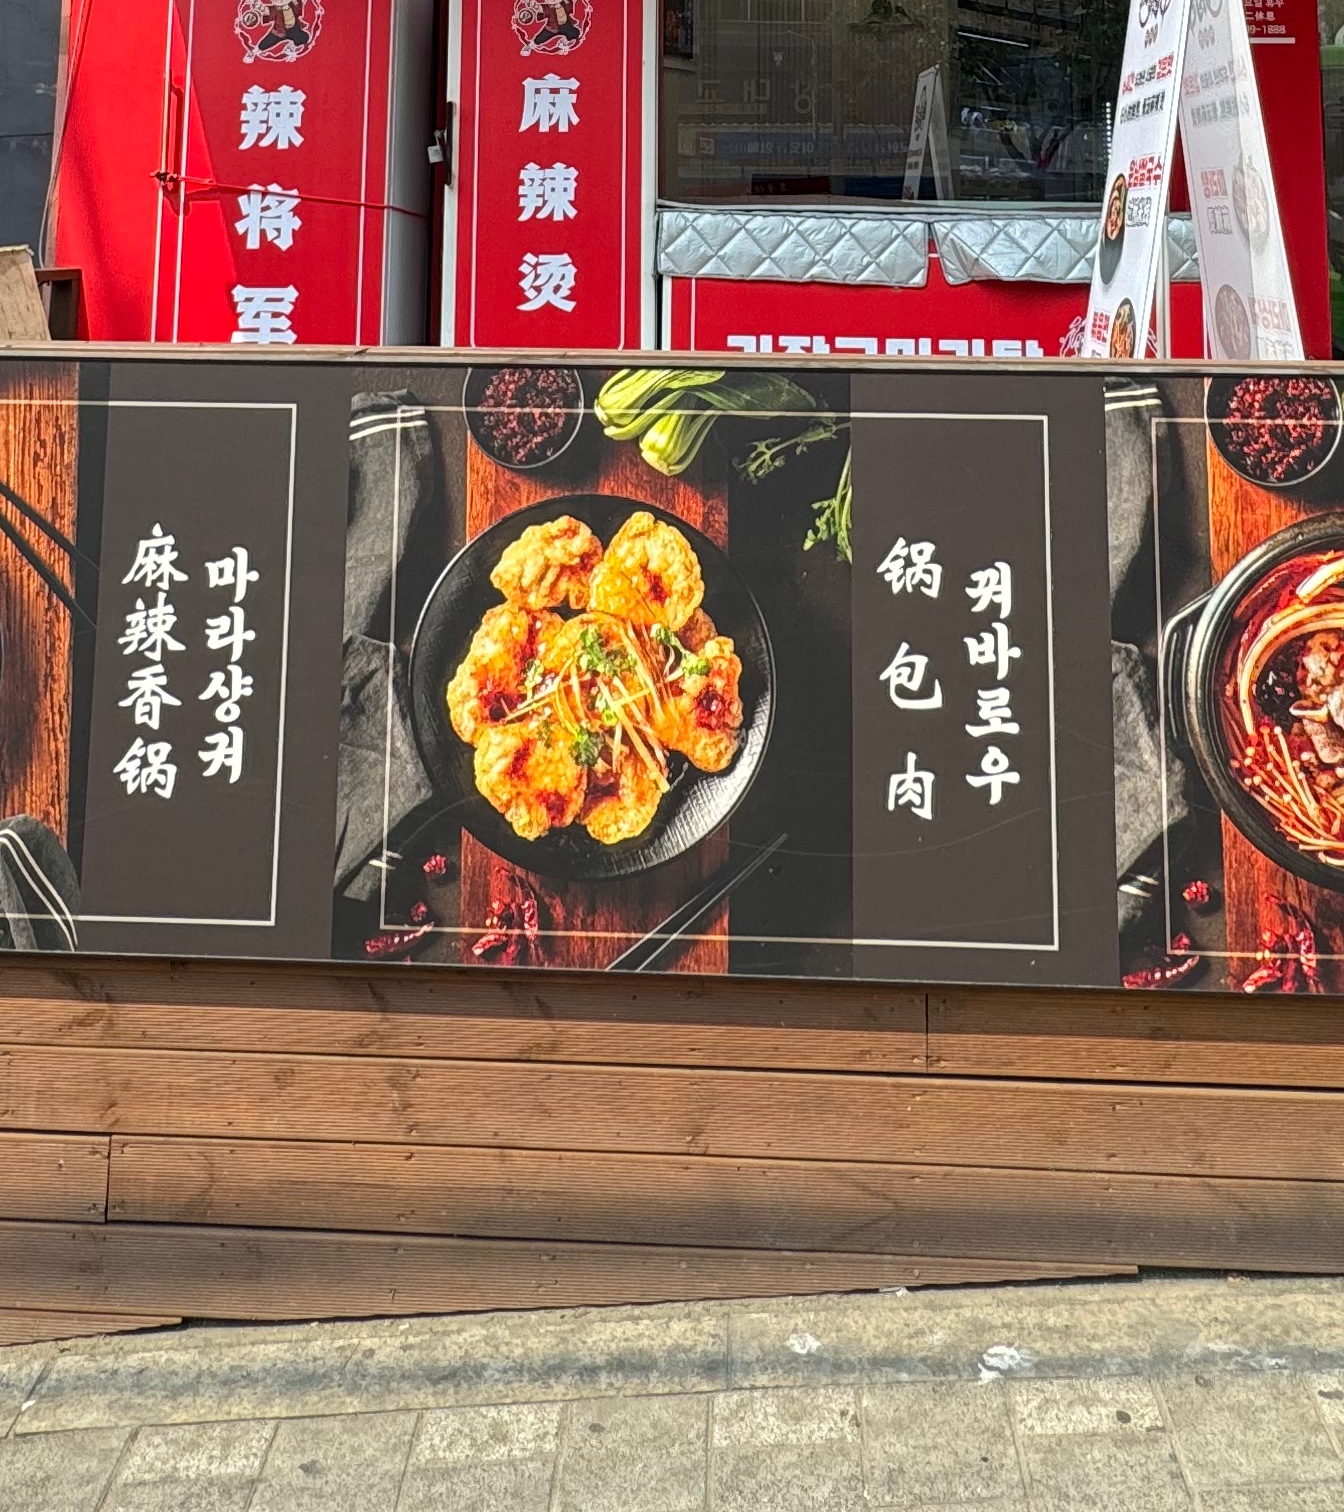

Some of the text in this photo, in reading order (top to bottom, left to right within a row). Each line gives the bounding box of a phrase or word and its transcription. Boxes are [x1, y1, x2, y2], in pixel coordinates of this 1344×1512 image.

[230, 84, 307, 345] 辣将军
[516, 73, 581, 314] 麻辣烫
[112, 521, 190, 800] 麻辣香锅
[876, 537, 944, 821] 锅包肉
